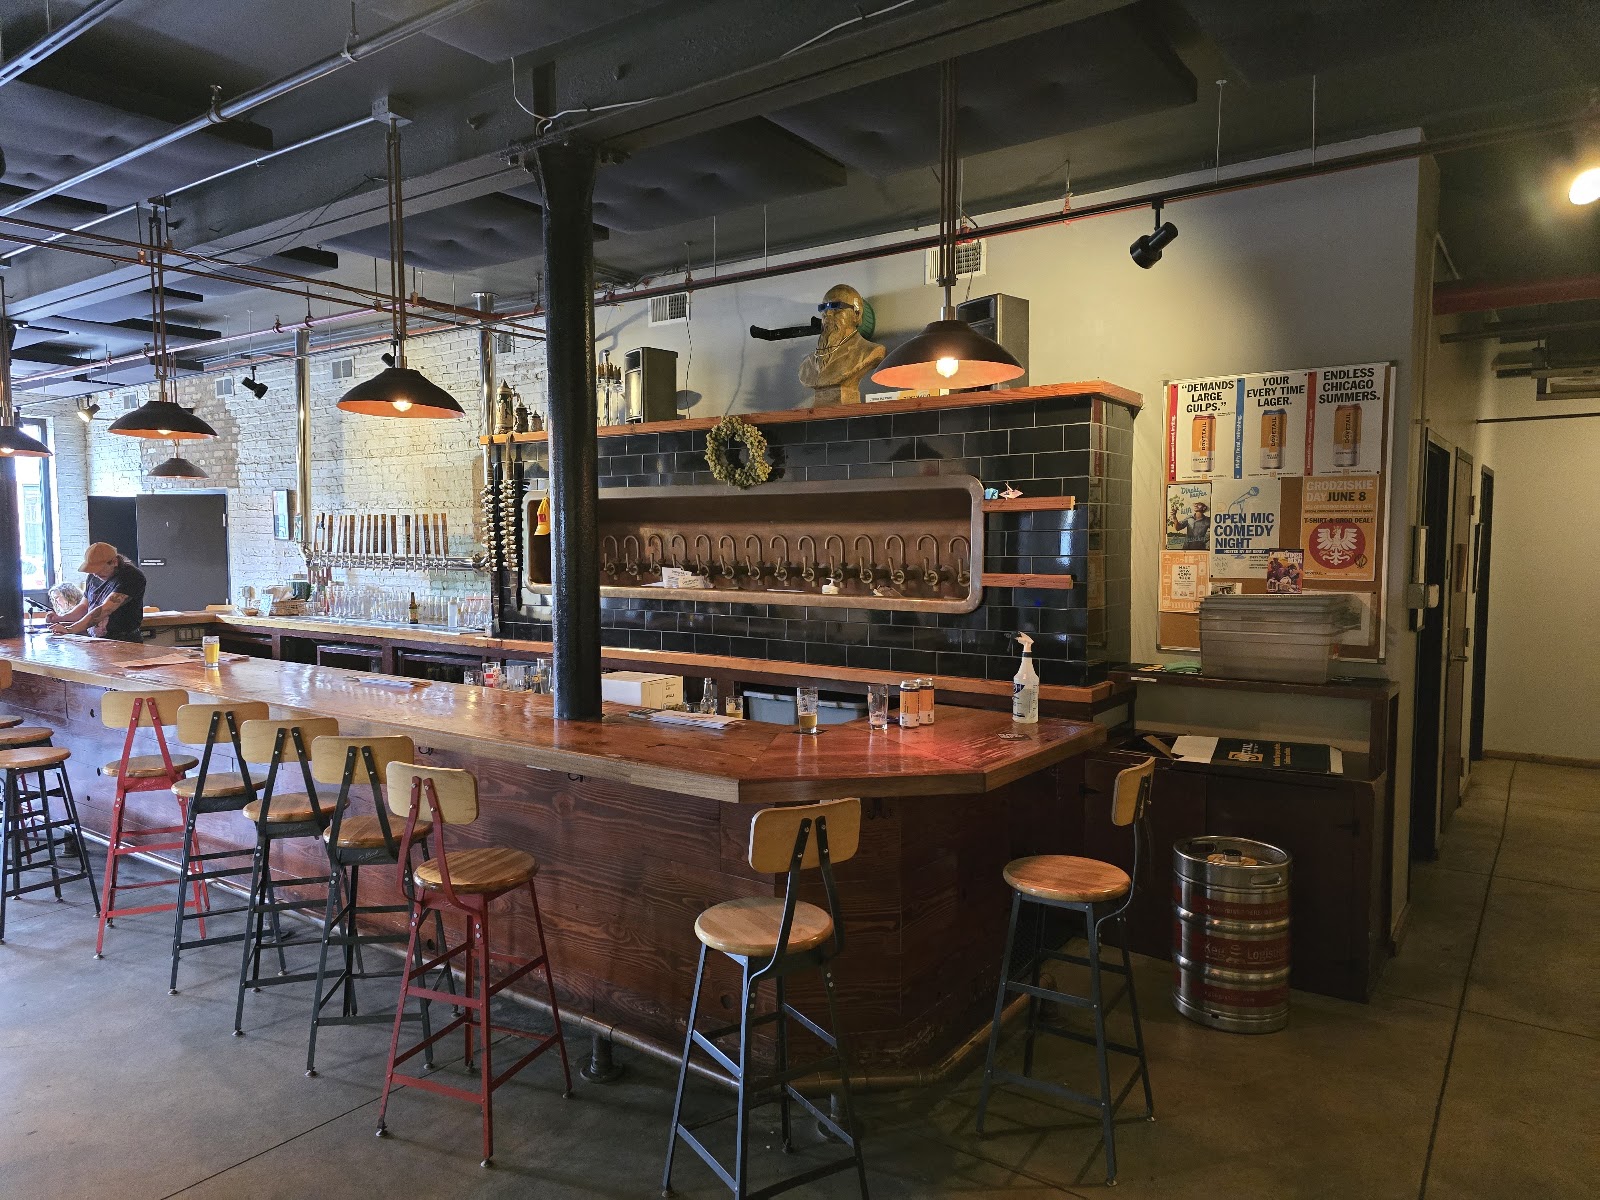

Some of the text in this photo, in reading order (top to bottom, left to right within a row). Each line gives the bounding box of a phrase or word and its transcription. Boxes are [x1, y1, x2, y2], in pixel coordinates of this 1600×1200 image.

[1323, 368, 1375, 380] ENDLESS
[1262, 375, 1290, 387] YOUR
[1323, 379, 1374, 392] CHICAGO
[1191, 392, 1223, 402] LARGE
[1247, 385, 1305, 398] EVERY TIME
[1319, 391, 1380, 404] SUMMERS.
[1257, 397, 1292, 407] LAGER.
[1307, 480, 1374, 491] GRODZISKIE
[1307, 491, 1367, 502] DAY JUNE 8
[1214, 512, 1275, 524] OPEN MIC
[1214, 524, 1274, 537] COMEDY
[1215, 537, 1252, 549] NIGHT
